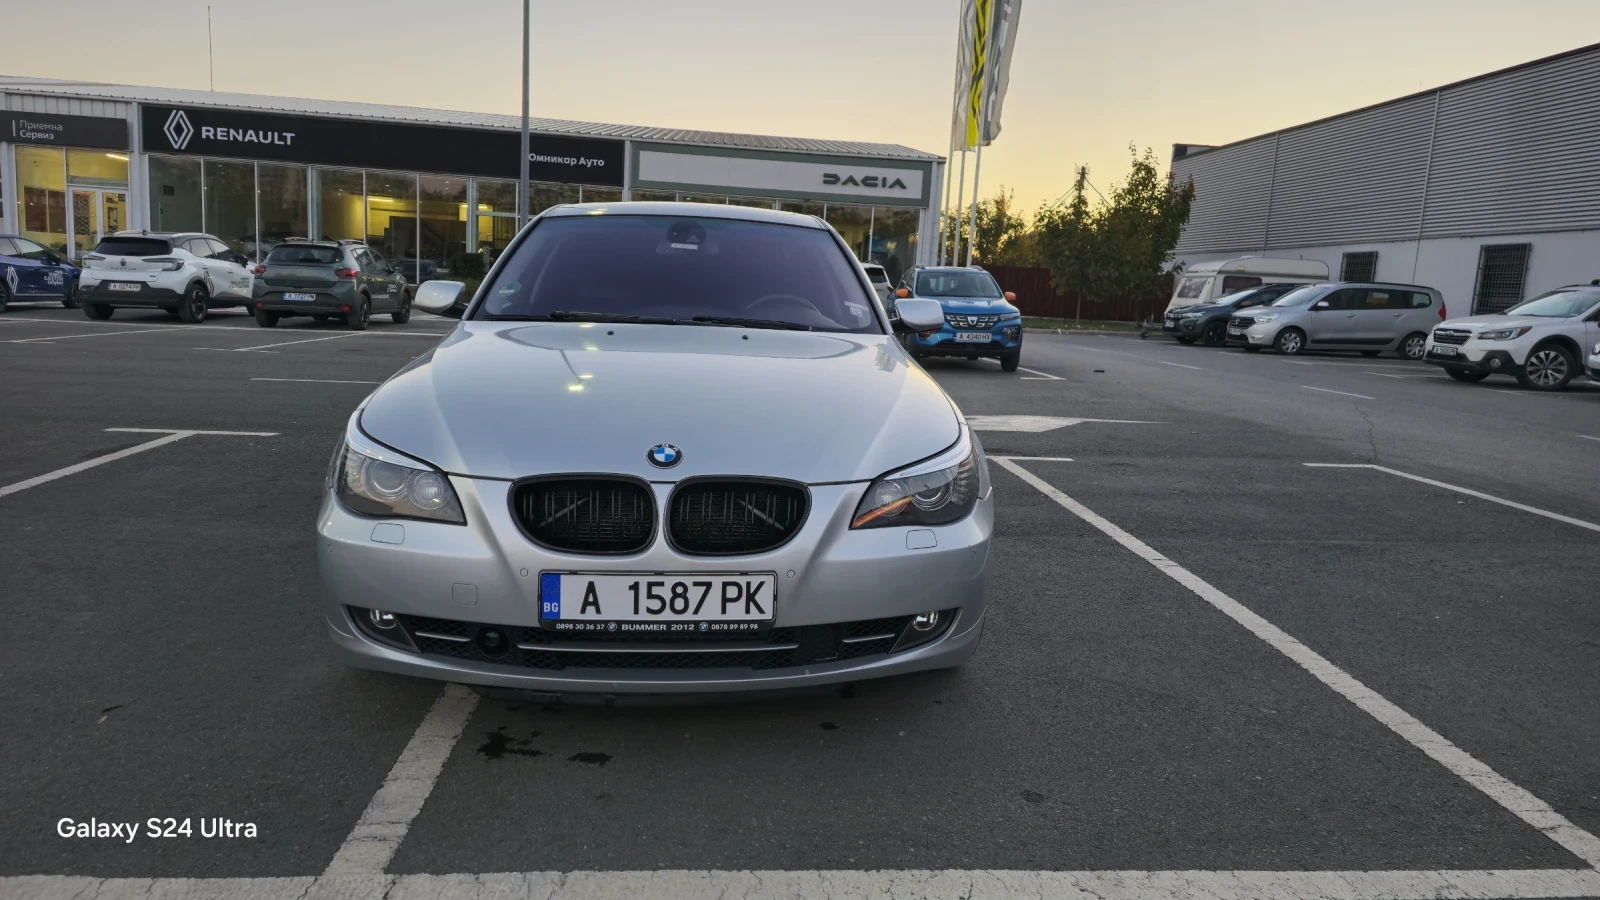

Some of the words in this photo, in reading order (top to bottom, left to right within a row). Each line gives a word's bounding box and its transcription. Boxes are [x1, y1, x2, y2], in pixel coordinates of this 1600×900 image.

[20, 120, 63, 131] Приемна
[20, 130, 54, 140] Сервиз
[201, 126, 296, 146] RENAULT
[528, 153, 577, 166] Омникар
[578, 157, 605, 168] Ауто
[823, 173, 907, 190] DACIA
[579, 580, 602, 615] A
[628, 580, 713, 616] 1587
[720, 580, 766, 615] PK
[543, 602, 559, 613] BG
[621, 623, 667, 631] BUMMER
[671, 623, 695, 631] 2012
